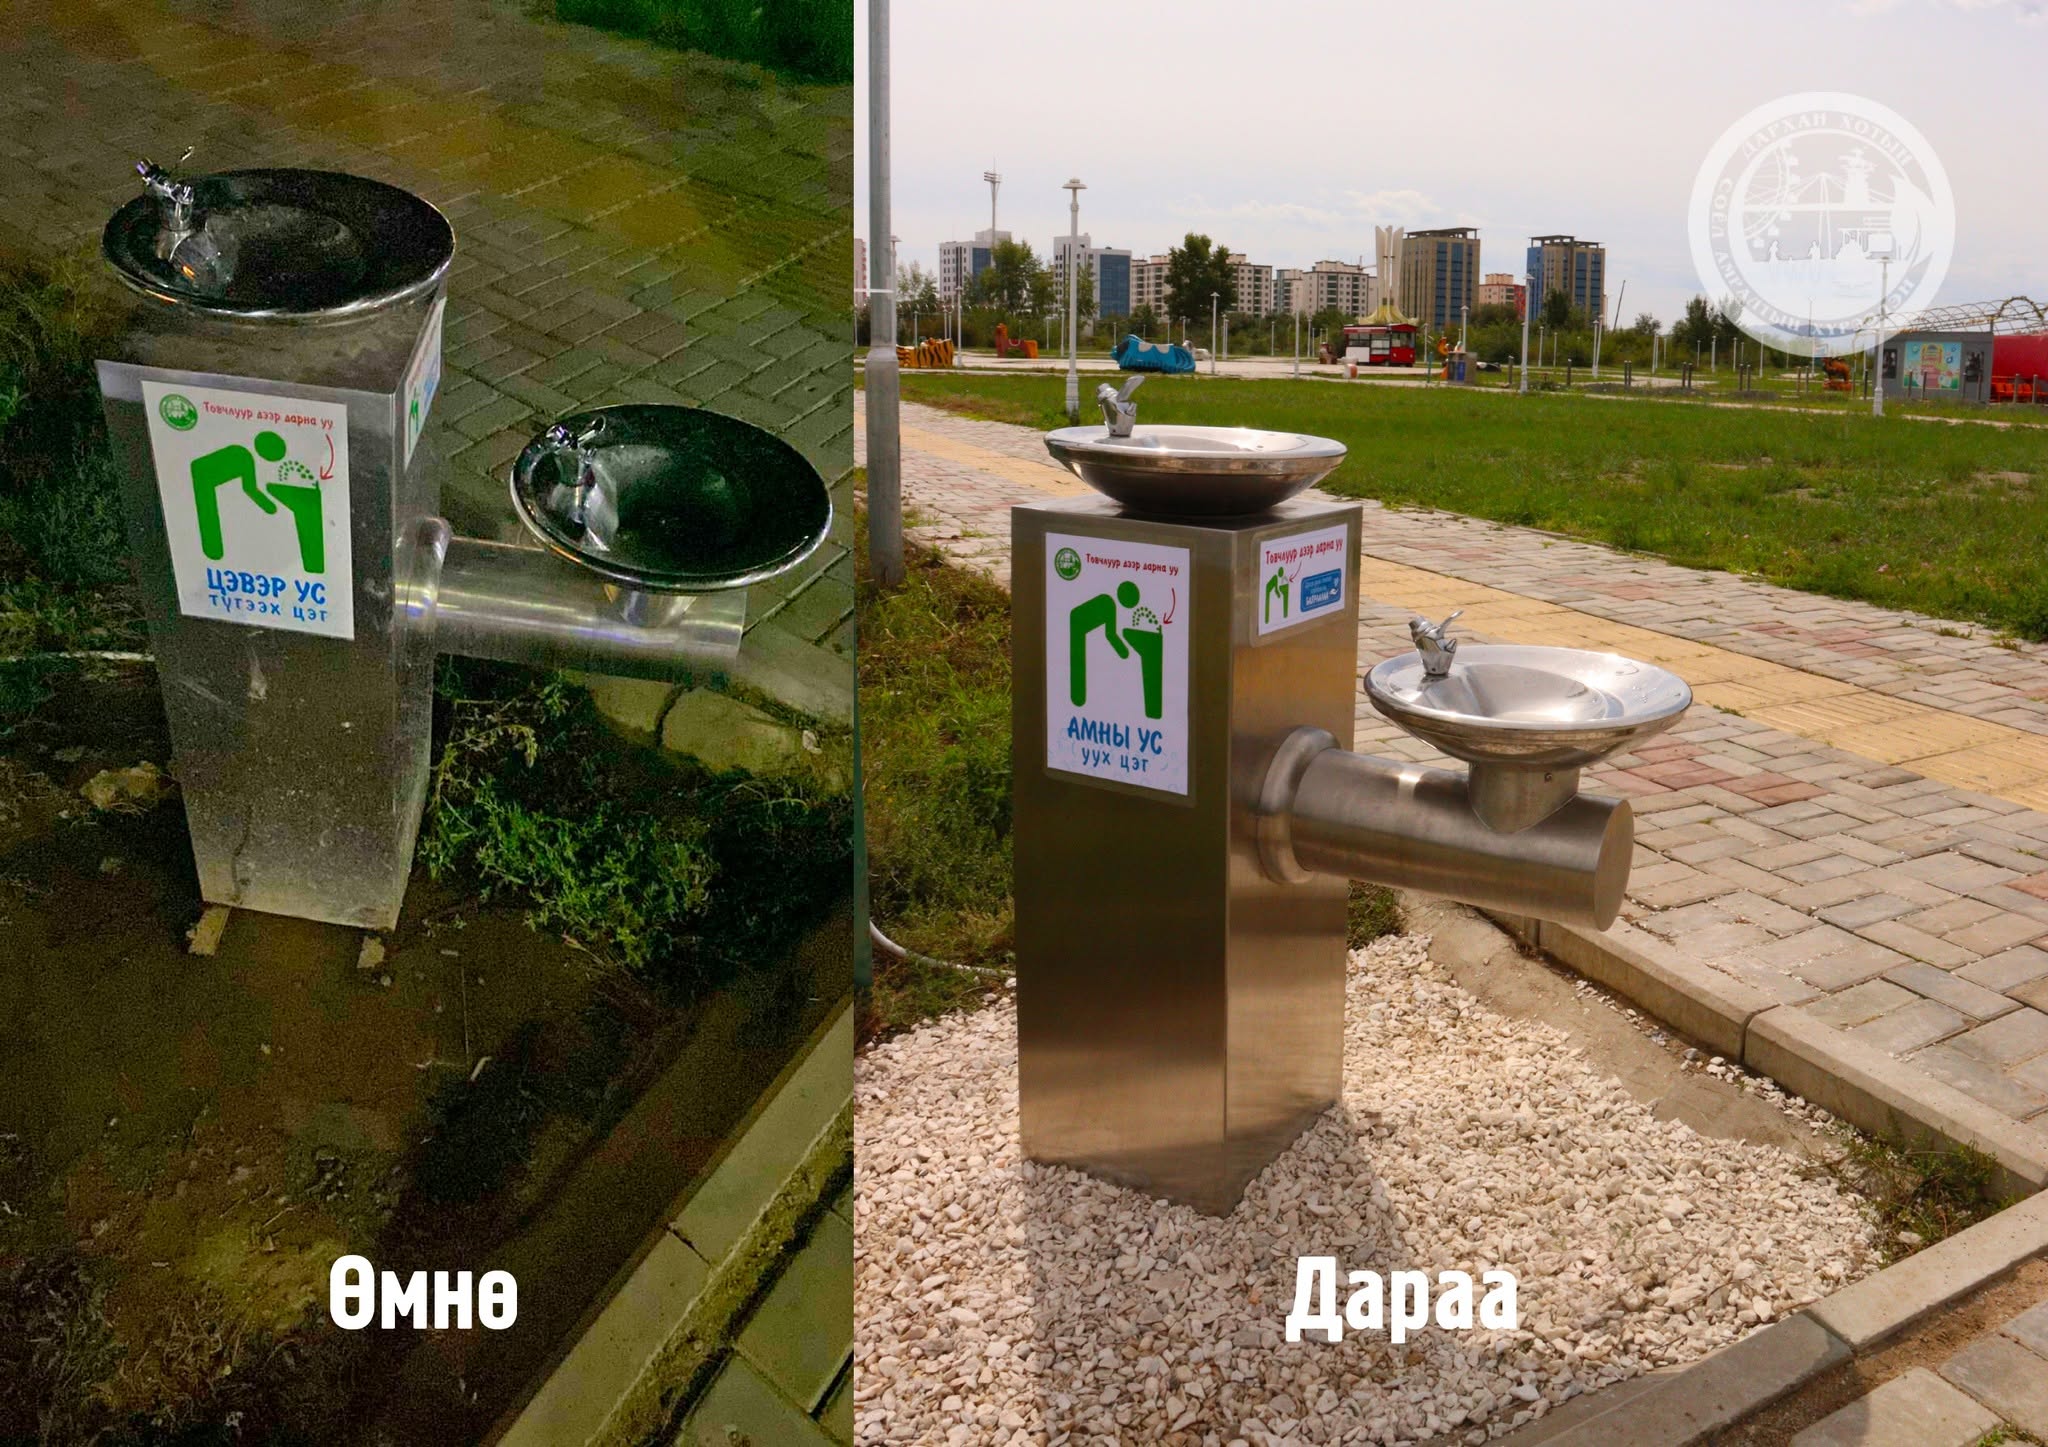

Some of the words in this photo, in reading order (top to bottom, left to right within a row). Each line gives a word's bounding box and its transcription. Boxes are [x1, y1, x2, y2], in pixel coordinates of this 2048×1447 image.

[204, 401, 253, 419] Товчлуур
[257, 408, 281, 424] дээр
[284, 413, 317, 427] дарна
[321, 419, 333, 430] уу
[1086, 553, 1120, 569] Товчлуур
[1122, 560, 1141, 572] дээр
[1142, 562, 1167, 574] дарна
[1168, 565, 1180, 576] уу
[1265, 549, 1297, 564] Товчлуур
[1299, 545, 1314, 558] дээр
[1315, 539, 1335, 554] дарна
[206, 567, 287, 599] ЦЭВЭР
[294, 578, 327, 605] УС
[1068, 717, 1129, 749] АМНЫ
[1138, 728, 1162, 754] УС
